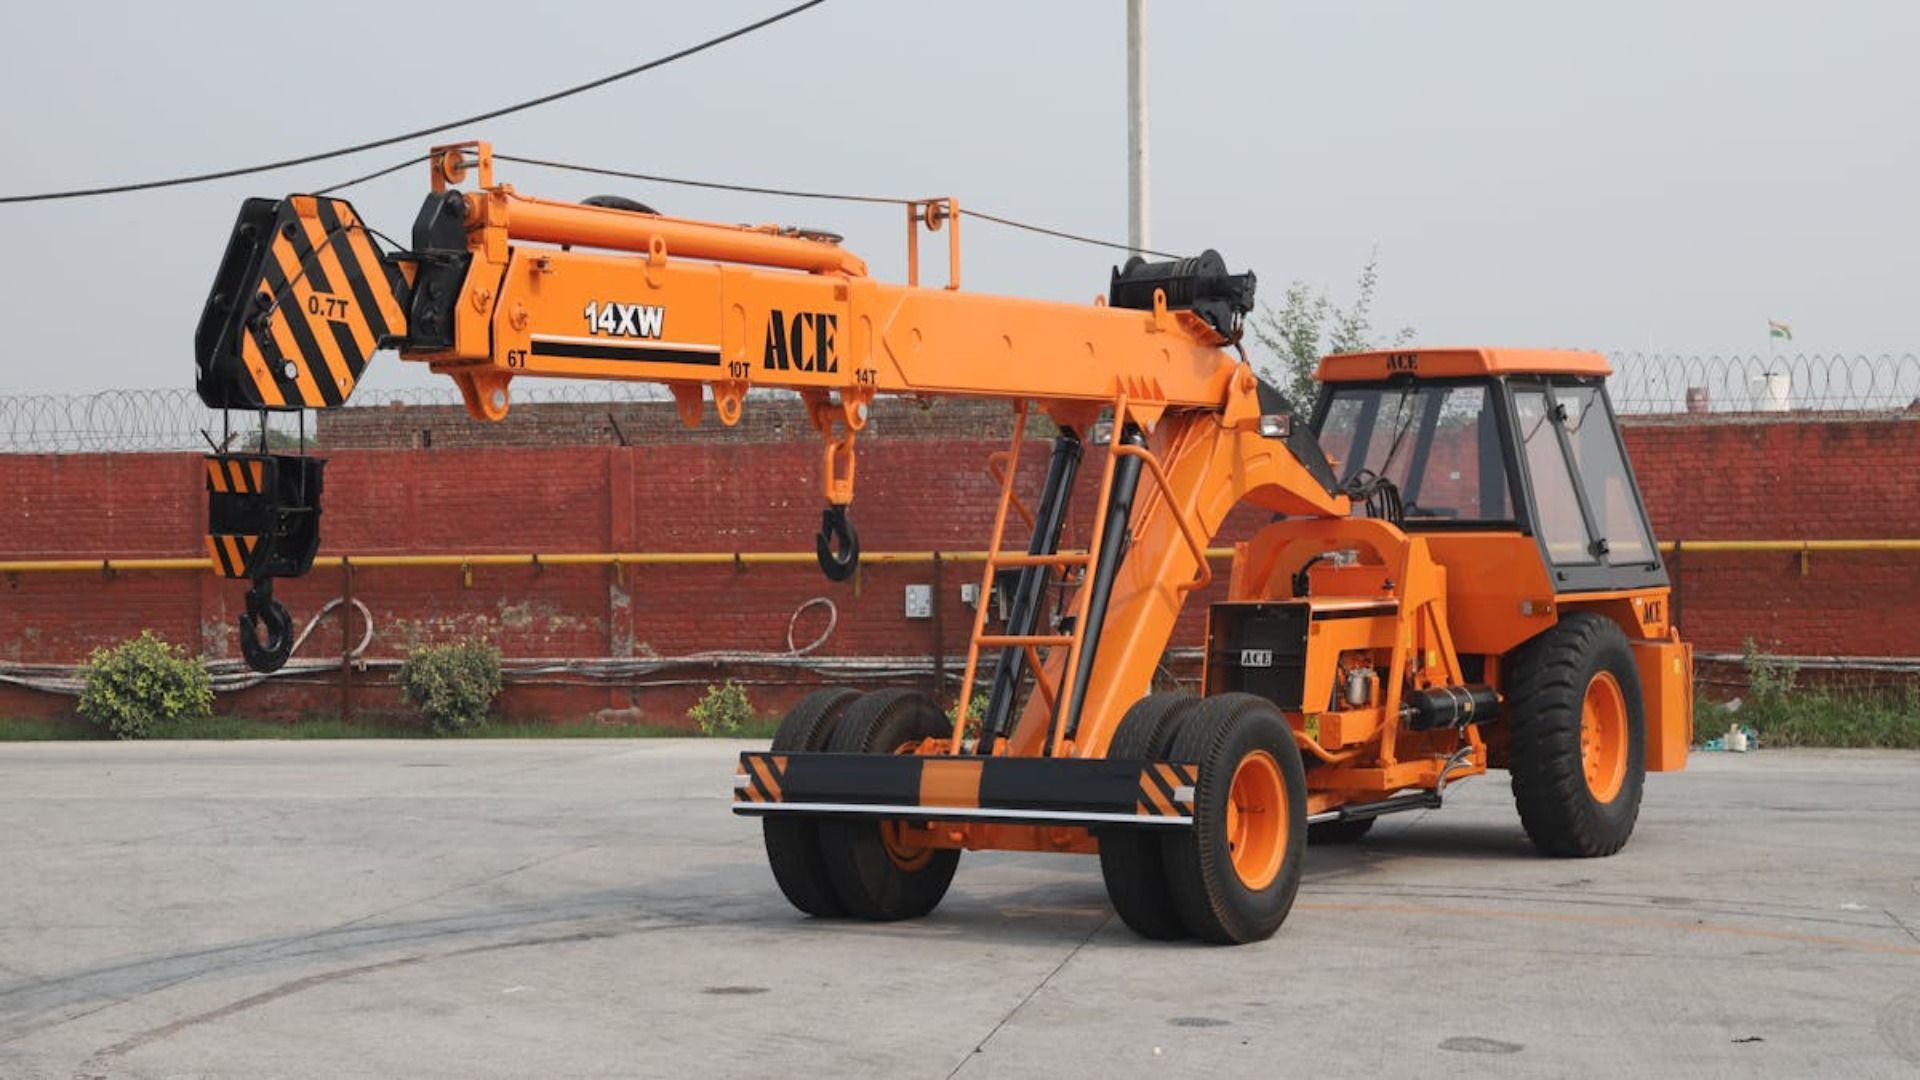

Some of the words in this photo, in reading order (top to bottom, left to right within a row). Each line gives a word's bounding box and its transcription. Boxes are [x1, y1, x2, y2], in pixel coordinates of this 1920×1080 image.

[308, 295, 349, 319] 0.7T
[584, 300, 665, 339] 14XW
[763, 309, 838, 373] ACE
[508, 349, 527, 368] 6T
[1386, 353, 1418, 370] ACE
[728, 360, 750, 378] 10T
[855, 368, 877, 385] 14T
[1643, 601, 1661, 624] ACE
[1242, 651, 1271, 665] ACE
